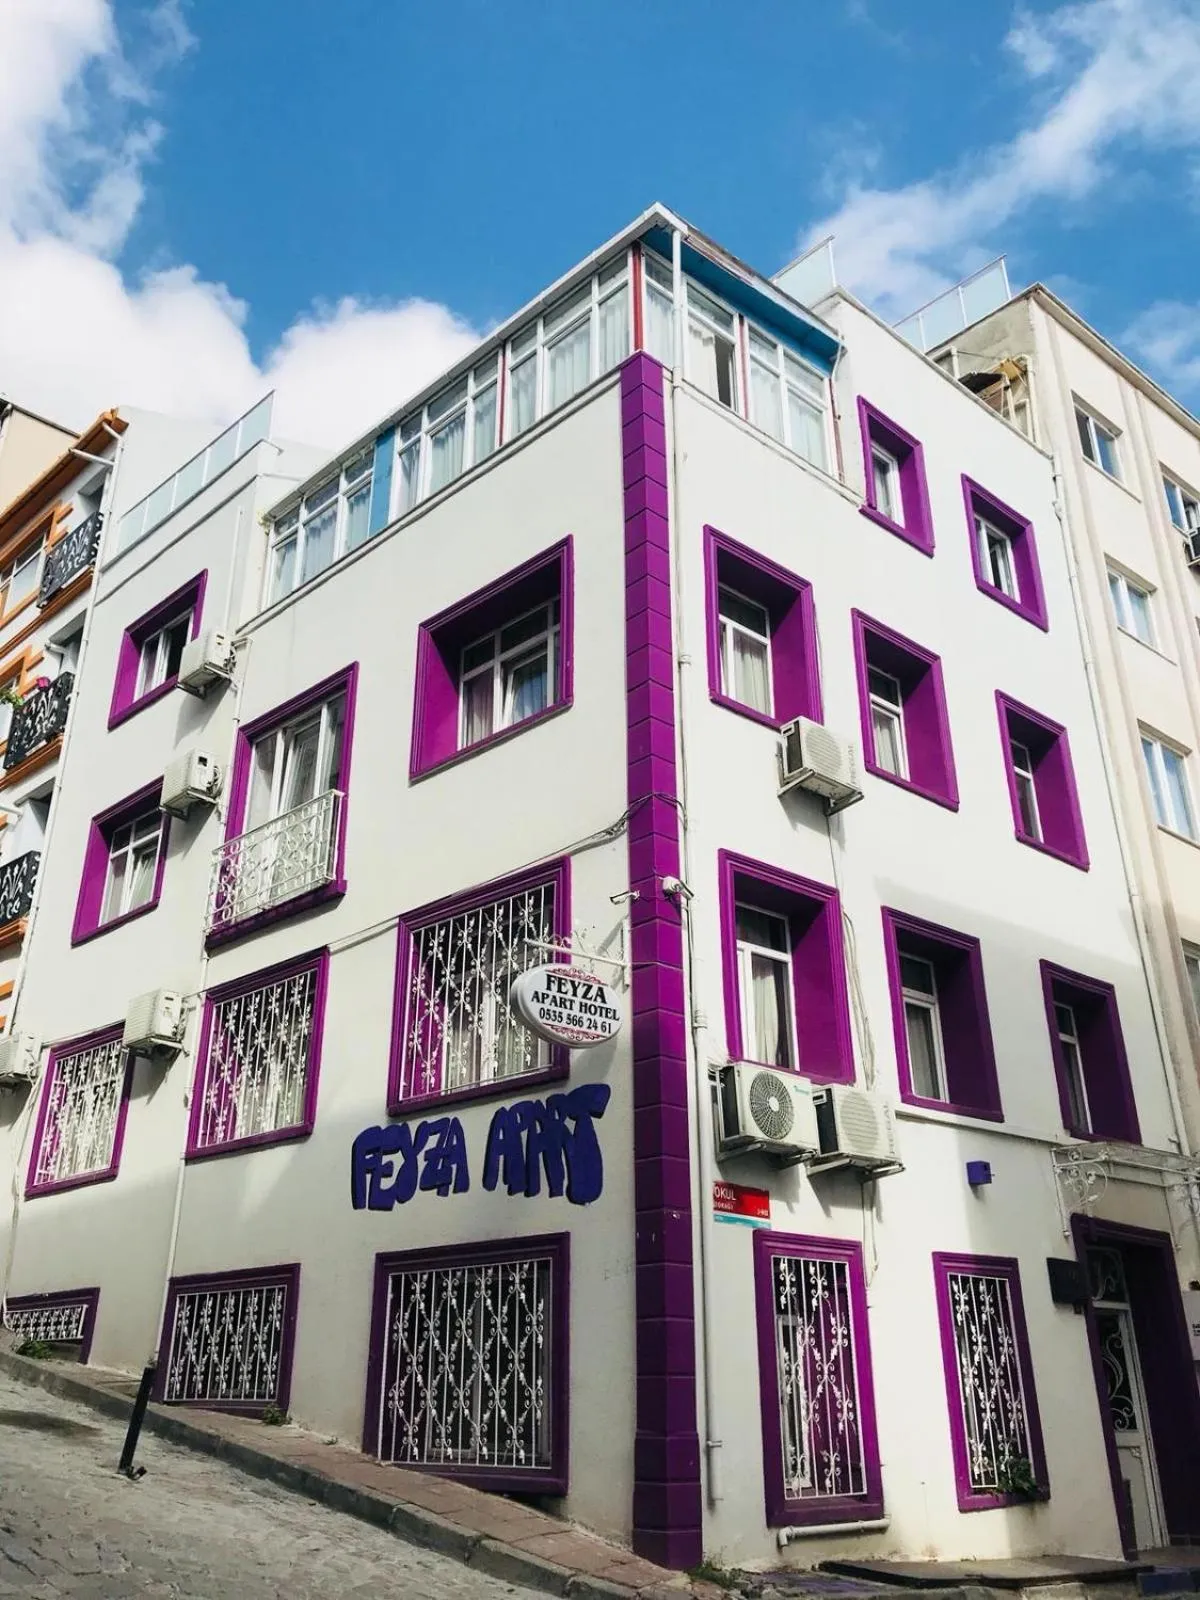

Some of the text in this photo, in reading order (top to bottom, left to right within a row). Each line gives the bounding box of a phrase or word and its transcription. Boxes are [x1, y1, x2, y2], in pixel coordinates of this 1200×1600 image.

[545, 973, 608, 1005] FEYZA
[531, 990, 620, 1021] APART HOTEL
[539, 1007, 612, 1035] 0535 566 24 61
[351, 1084, 612, 1212] FEYZA APART
[714, 1185, 737, 1201] OKUL
